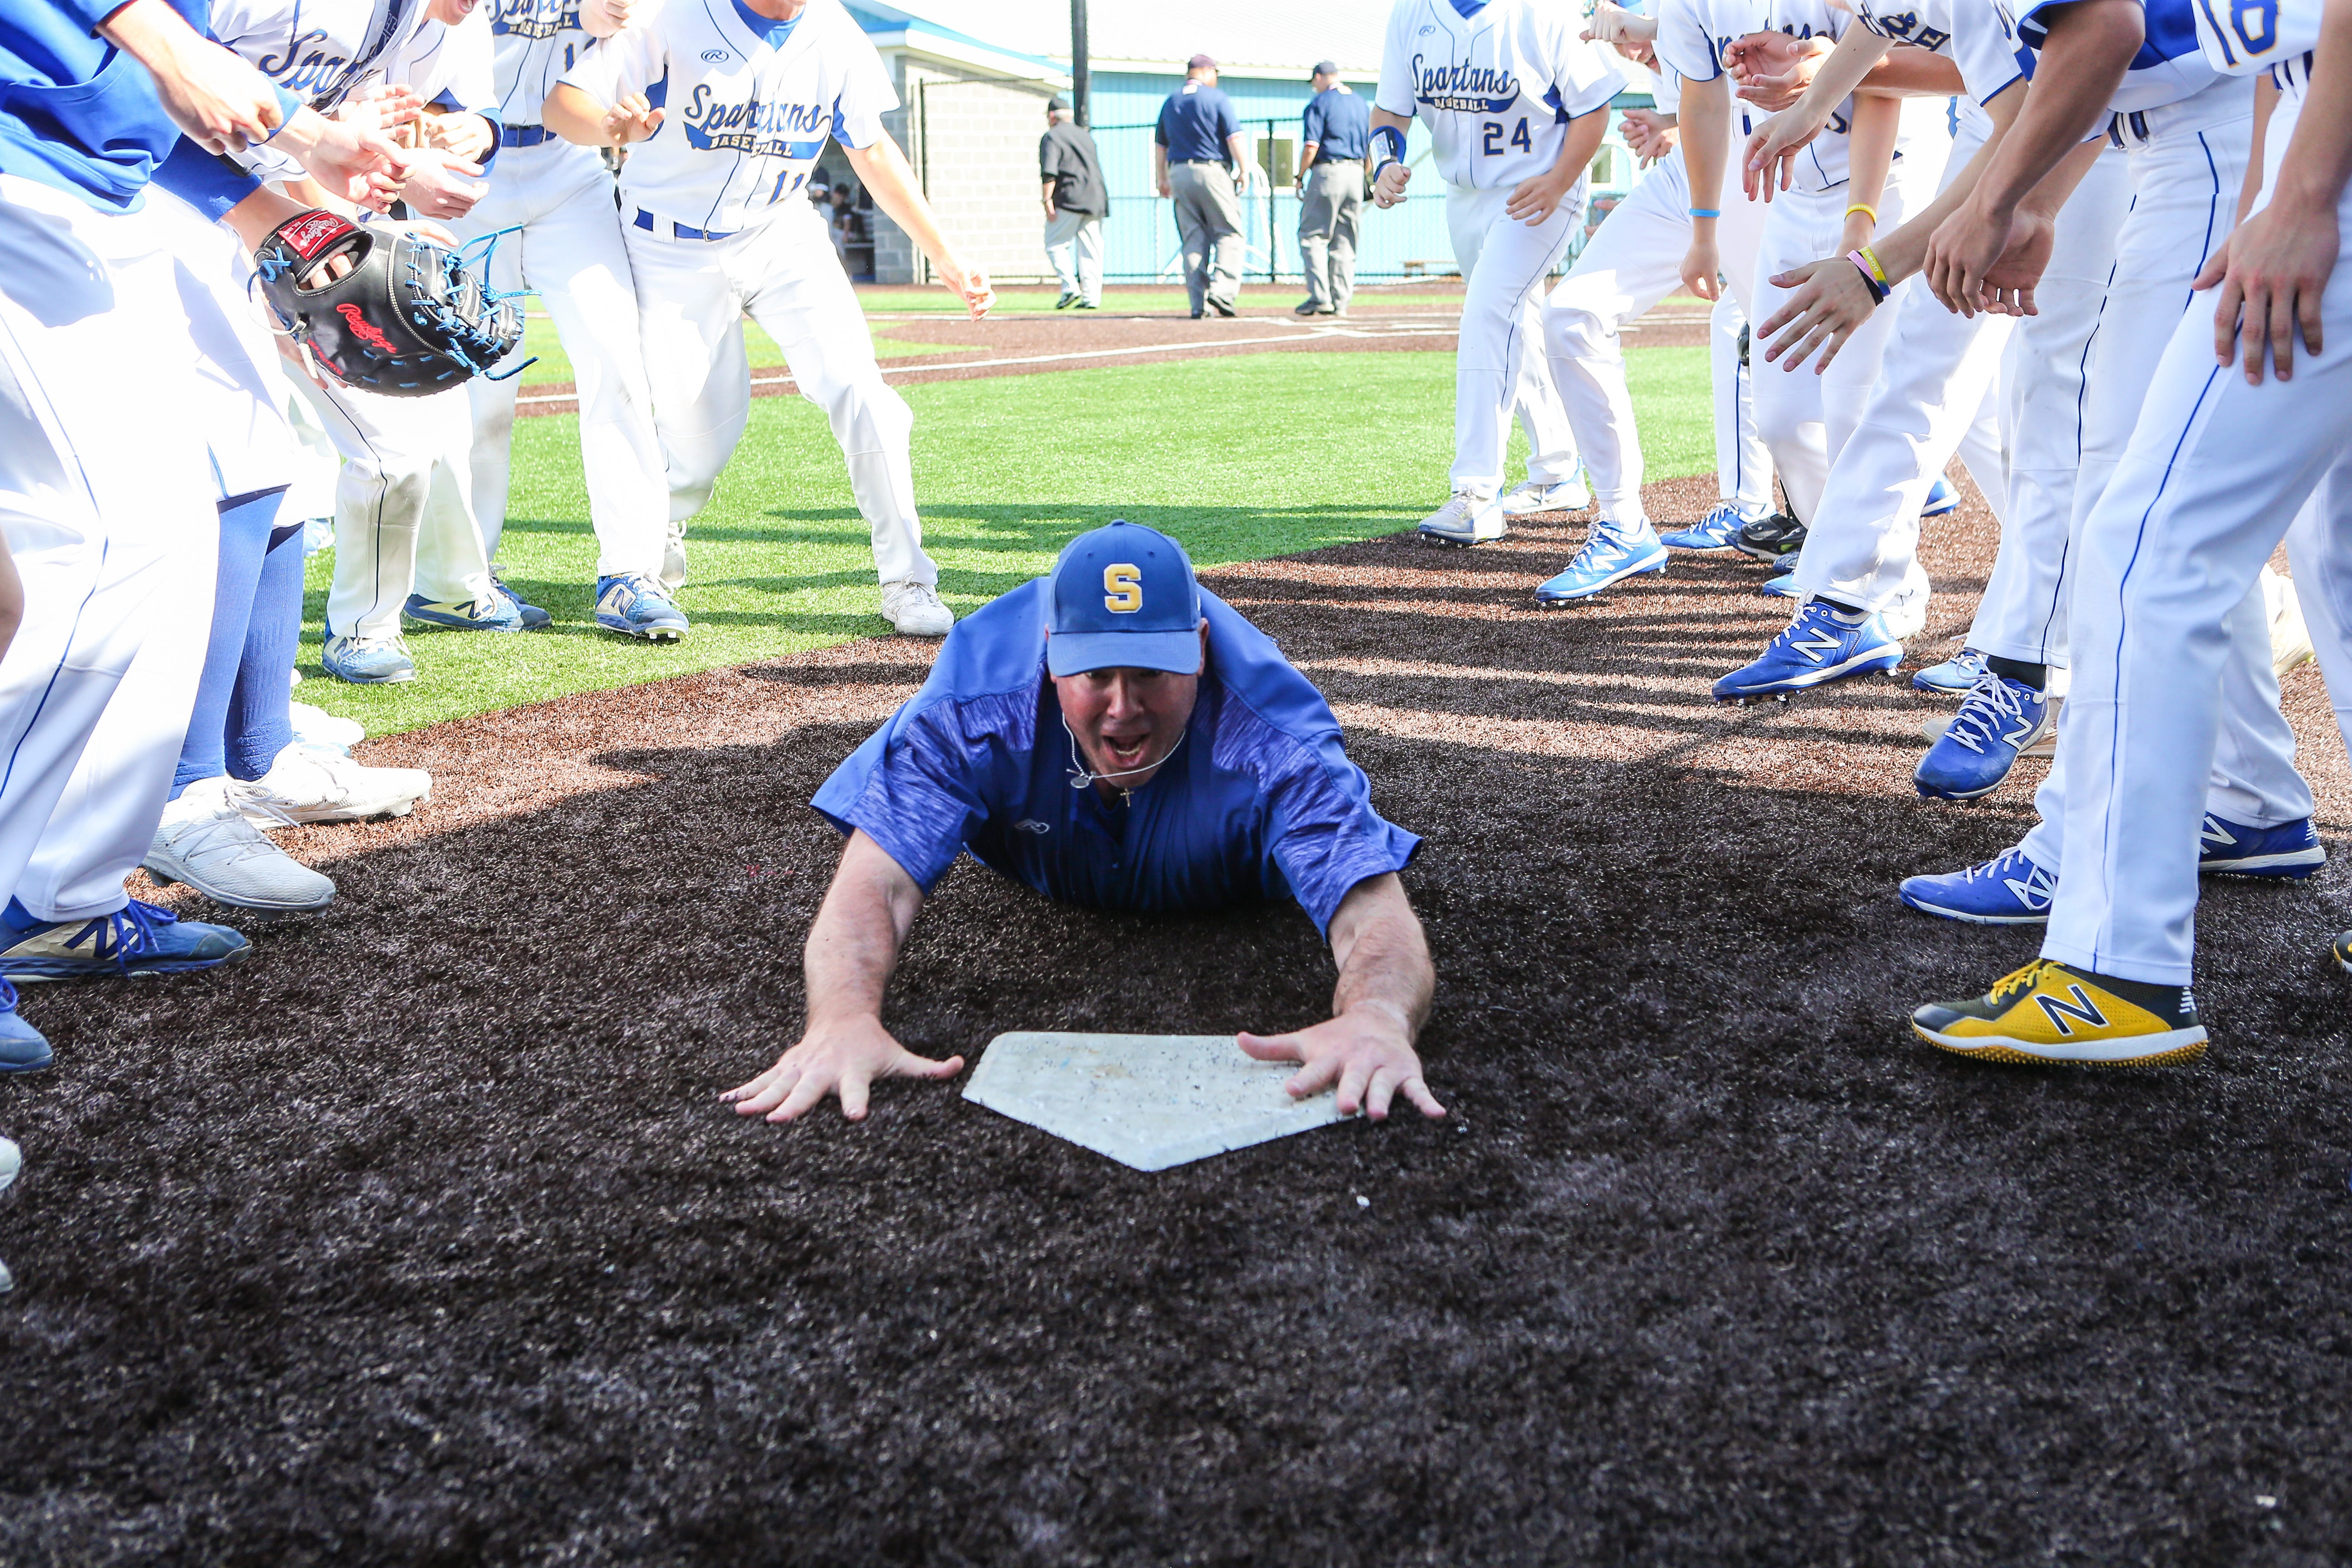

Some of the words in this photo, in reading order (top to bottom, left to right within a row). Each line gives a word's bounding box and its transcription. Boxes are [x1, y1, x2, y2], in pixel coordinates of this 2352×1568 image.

[1412, 54, 1519, 98] Spartans
[684, 84, 832, 134] Spartans
[1483, 117, 1532, 157] 24
[336, 303, 398, 353] Rawlings
[1591, 544, 1630, 571] N
[611, 588, 633, 617] N
[1103, 563, 1143, 614] S
[1789, 627, 1844, 663] N
[2000, 715, 2034, 751] N
[2032, 982, 2111, 1037] N
